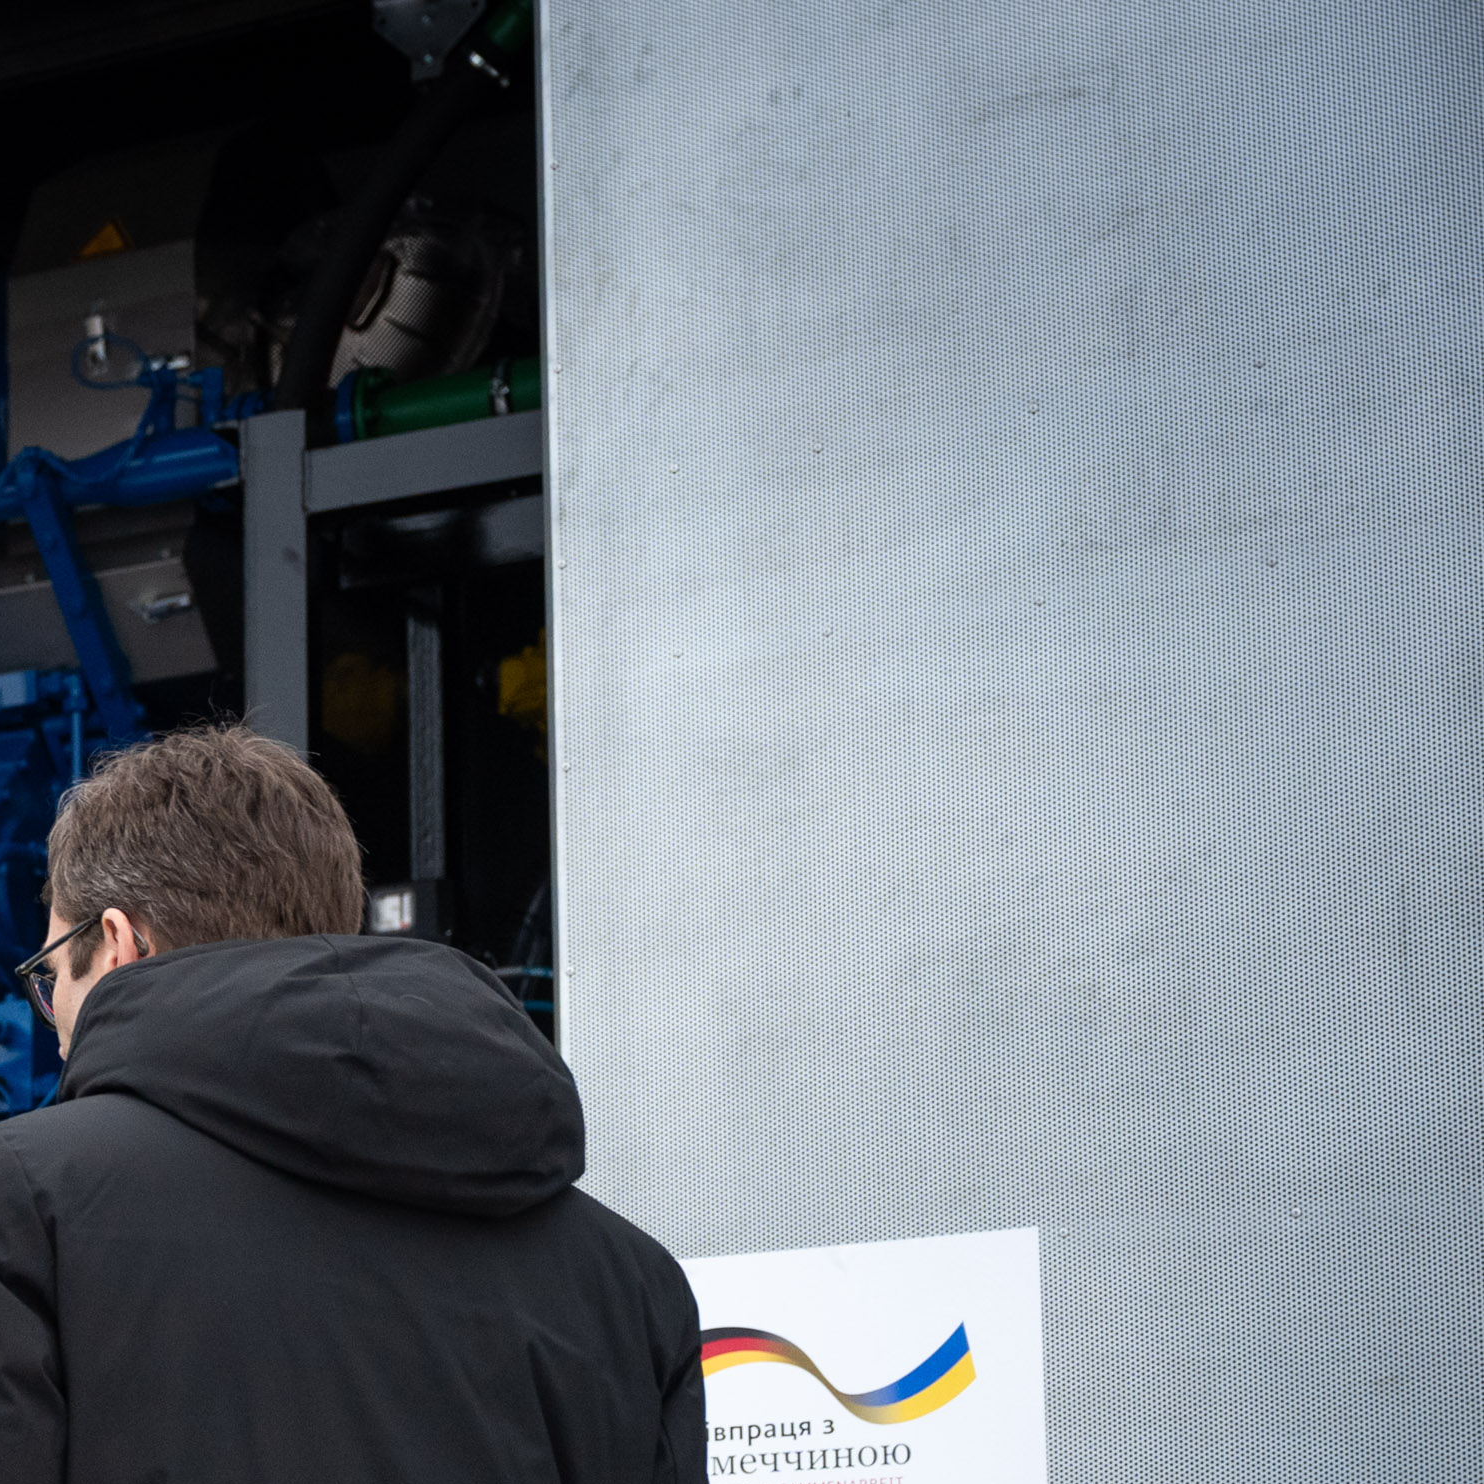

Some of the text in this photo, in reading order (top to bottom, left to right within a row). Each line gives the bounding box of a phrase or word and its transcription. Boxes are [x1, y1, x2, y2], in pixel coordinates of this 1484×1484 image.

[705, 1418, 835, 1447] івпраця з
[710, 1443, 912, 1476] меччиною
